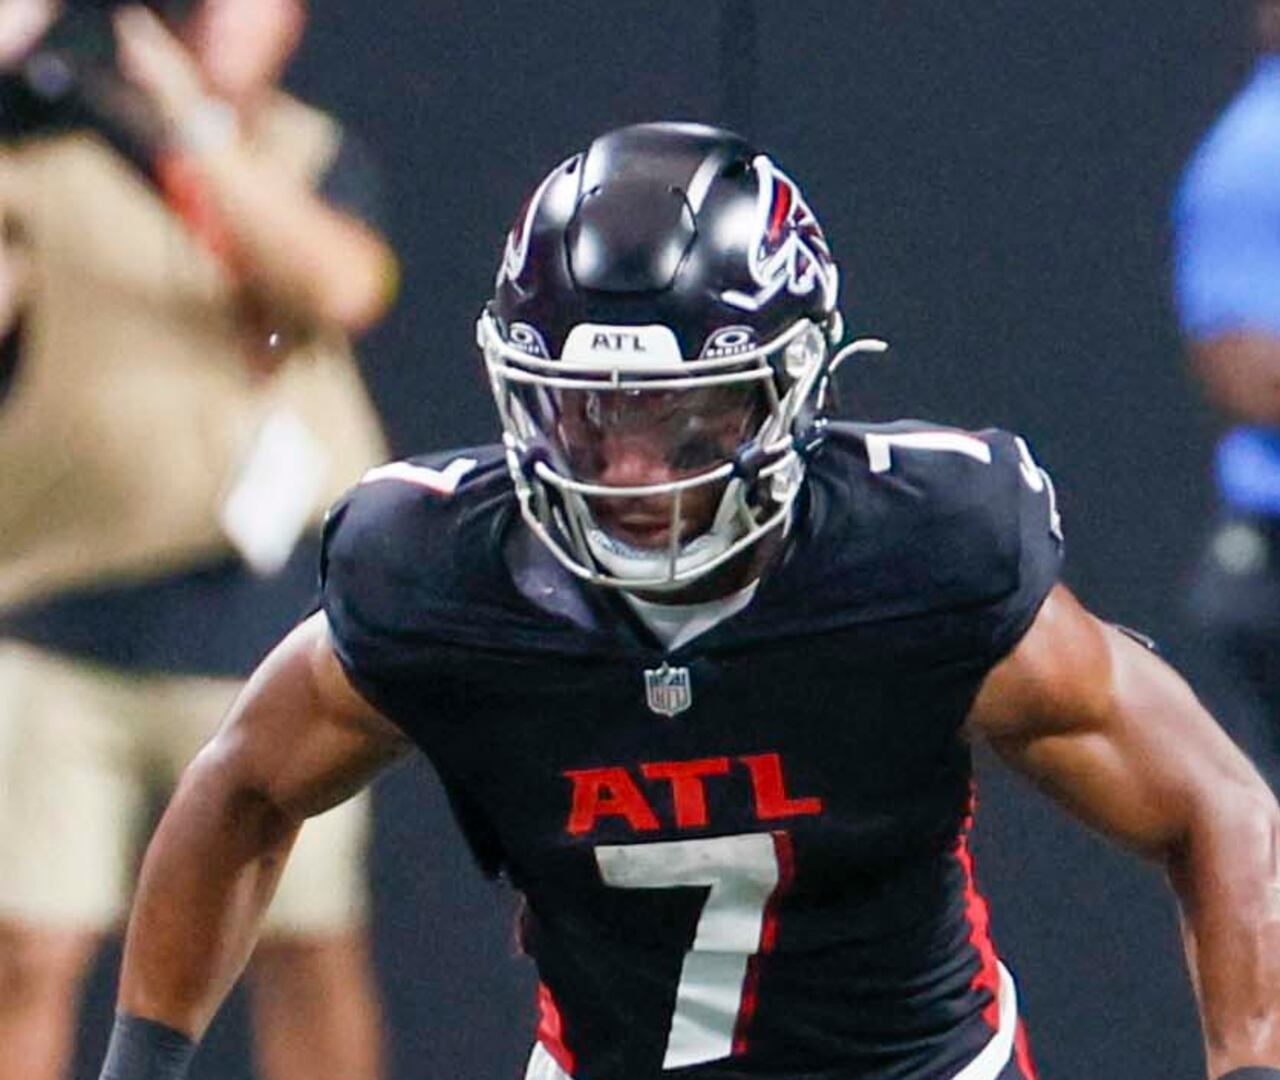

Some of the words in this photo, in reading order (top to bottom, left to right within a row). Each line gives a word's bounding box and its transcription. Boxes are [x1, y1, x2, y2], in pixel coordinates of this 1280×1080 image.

[591, 333, 647, 351] ATL
[562, 753, 823, 836] ATL
[594, 830, 790, 1071] 7
